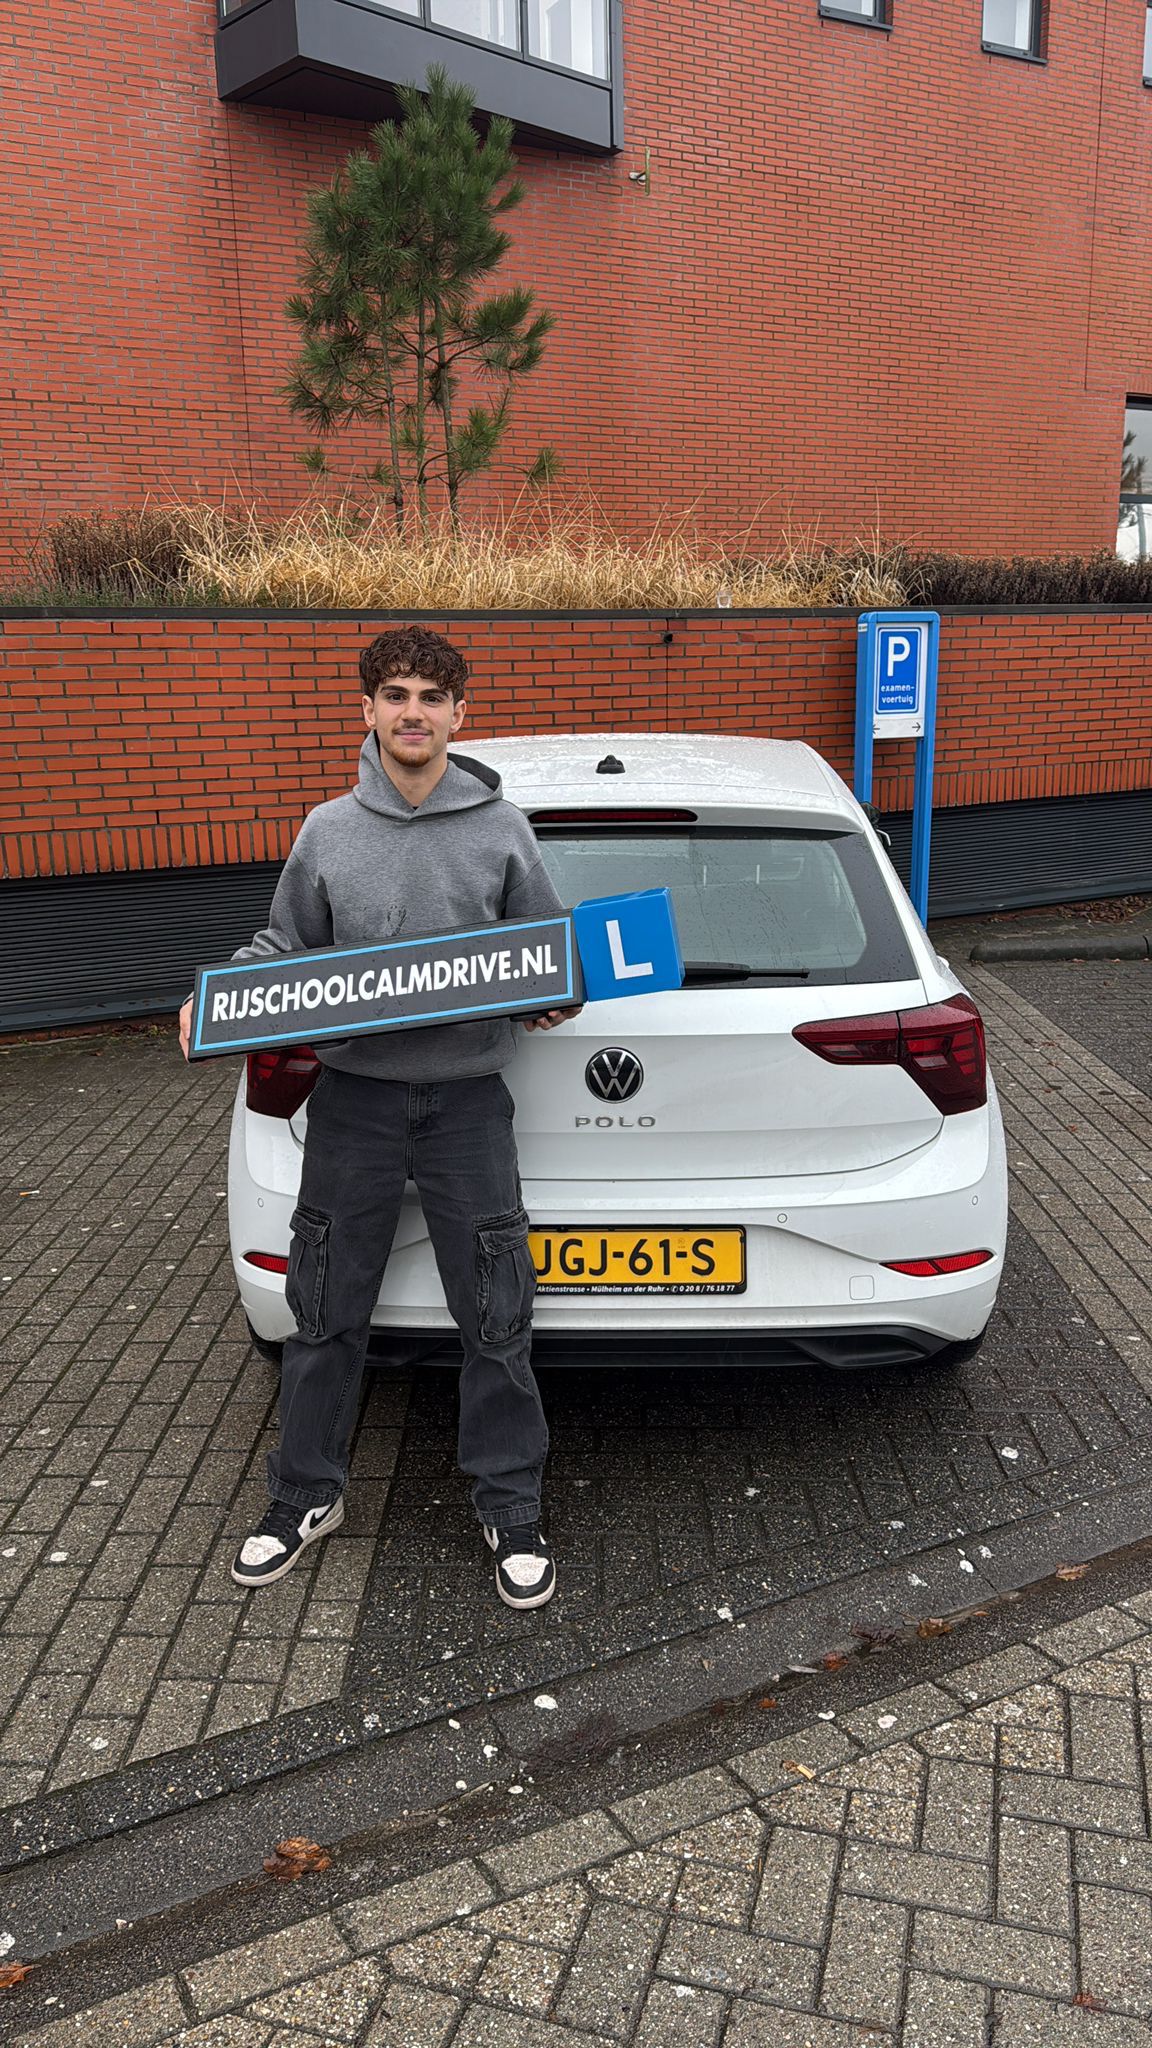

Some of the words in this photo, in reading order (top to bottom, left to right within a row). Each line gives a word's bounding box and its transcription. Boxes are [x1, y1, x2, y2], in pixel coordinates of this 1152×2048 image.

[887, 636, 911, 677] P
[881, 683, 915, 692] examen-
[881, 694, 914, 705] voertuig
[605, 919, 654, 980] L
[211, 944, 558, 1022] RIJSCHOOLCALMDRIVE.NL
[574, 1115, 656, 1128] POLO
[535, 1238, 716, 1277] JGJ-61-S
[536, 1285, 585, 1293] Aktienstrasse
[591, 1285, 622, 1293] Mülheim
[633, 1285, 646, 1293] der
[647, 1285, 665, 1293] Ruhr
